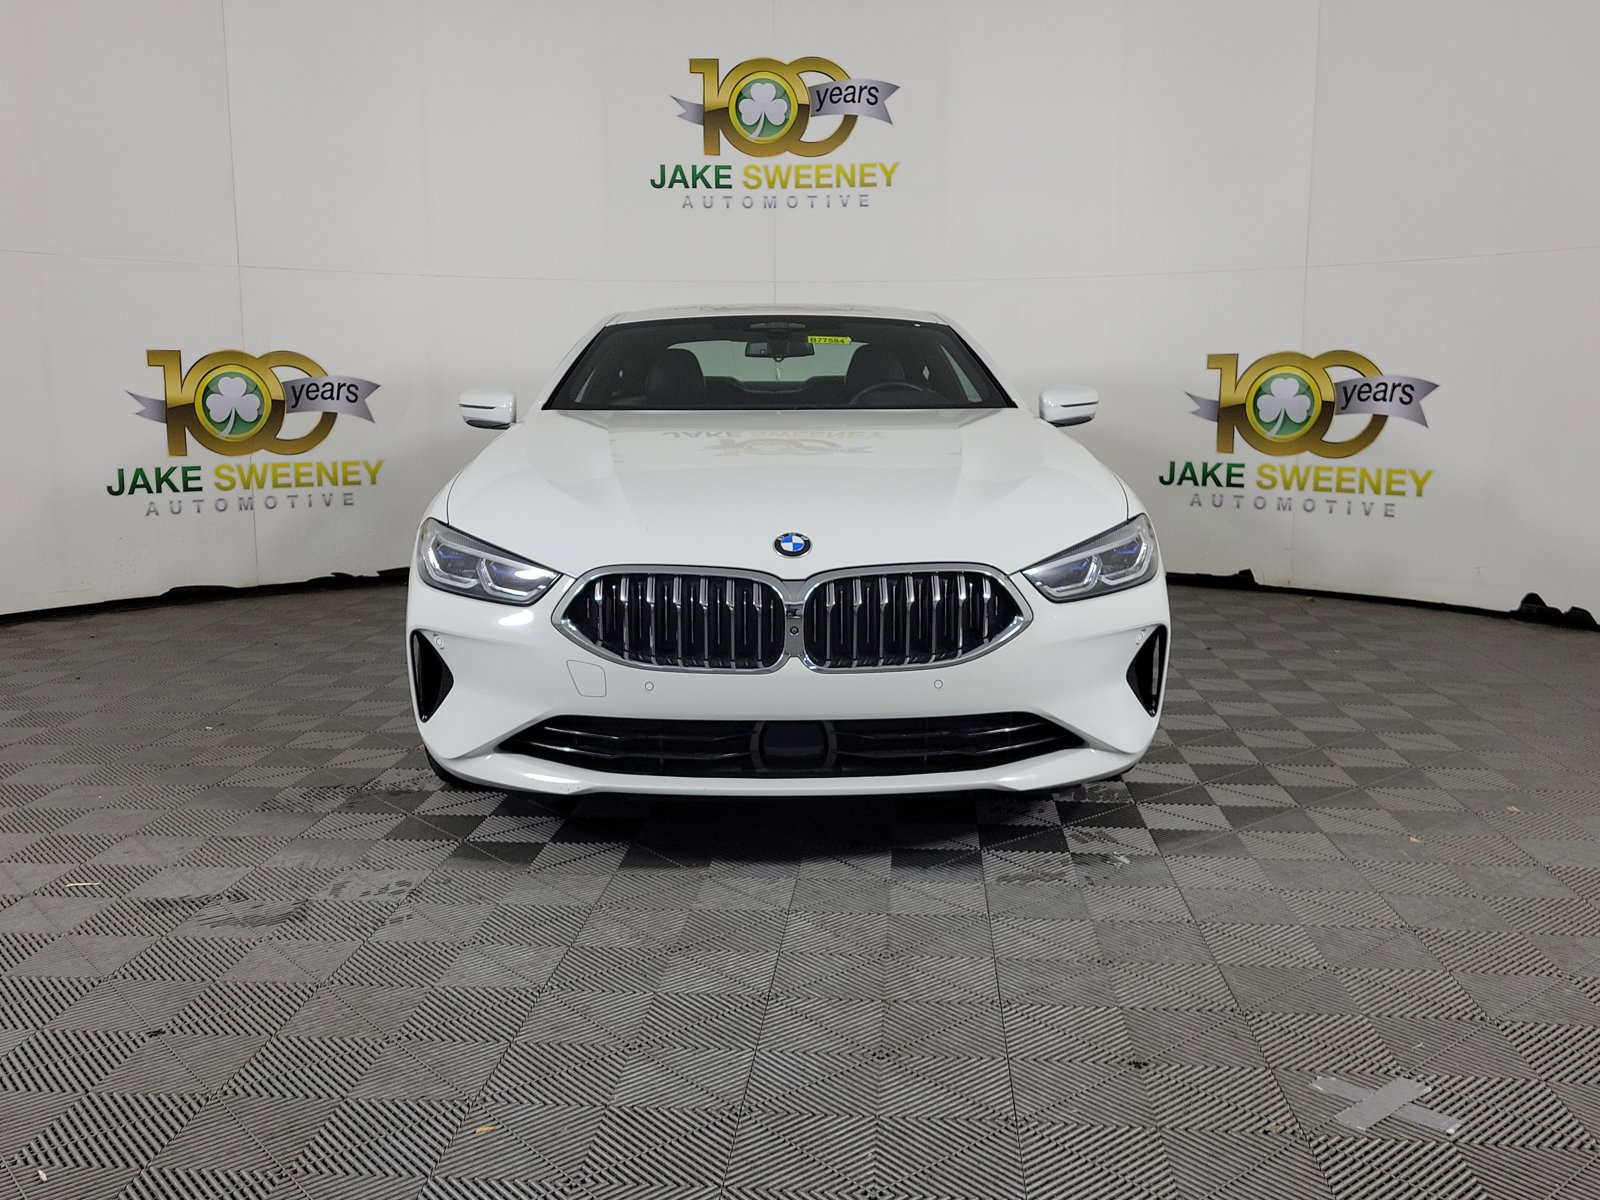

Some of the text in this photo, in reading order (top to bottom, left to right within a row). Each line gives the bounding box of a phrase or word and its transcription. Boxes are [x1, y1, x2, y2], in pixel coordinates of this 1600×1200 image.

[688, 56, 858, 157] 100
[815, 84, 879, 112] years
[650, 162, 899, 190] JAKE SWEENEY
[682, 194, 869, 209] AUTOMOTIVE
[809, 336, 845, 345] B77584
[146, 349, 338, 457] 100
[291, 381, 359, 408] years
[1207, 349, 1389, 459] 100
[1340, 381, 1415, 410] years
[106, 459, 385, 497] JAKE SWEENEY
[1158, 461, 1435, 497] JAKE SWEENEY
[145, 492, 355, 517] AUTOMOTIVE
[1190, 493, 1396, 518] AUTOMOTIVE
